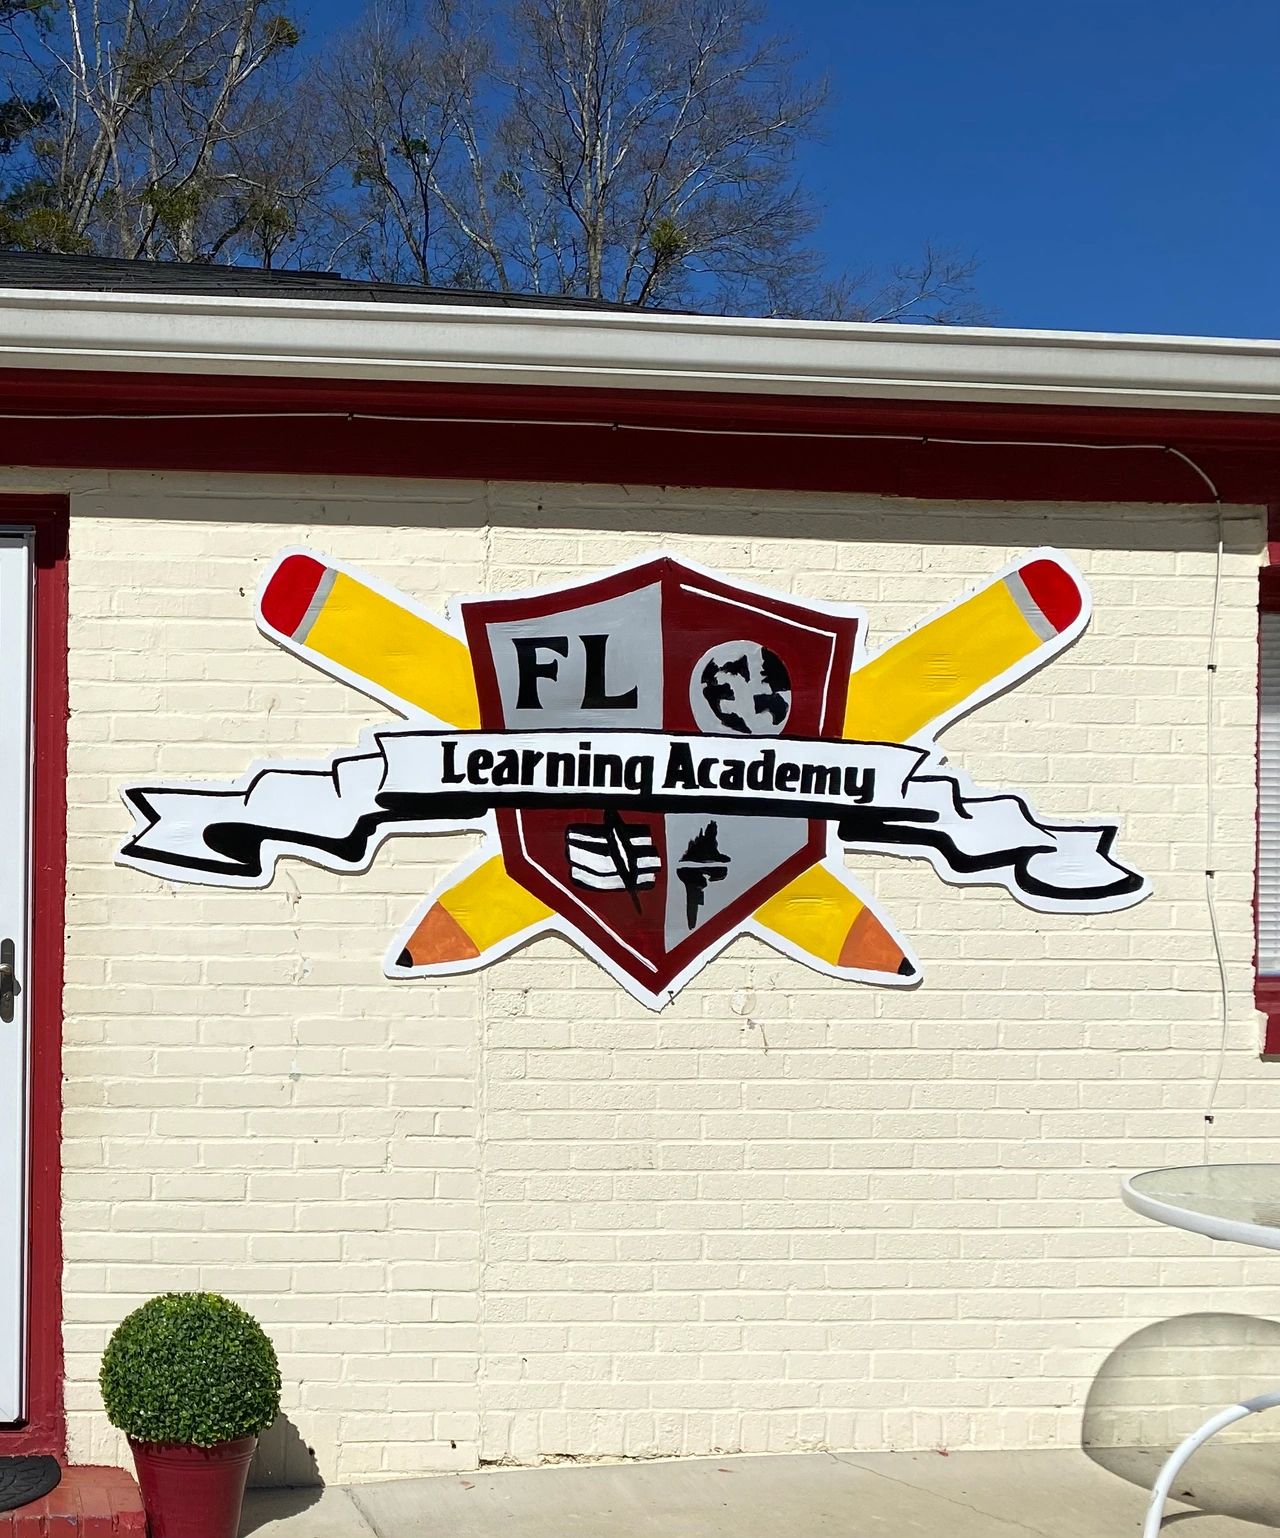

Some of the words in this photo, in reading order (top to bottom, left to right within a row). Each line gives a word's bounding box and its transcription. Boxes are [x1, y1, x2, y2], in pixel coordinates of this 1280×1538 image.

[510, 634, 640, 712] FL
[439, 738, 656, 796] Learning
[661, 740, 878, 805] Academy
